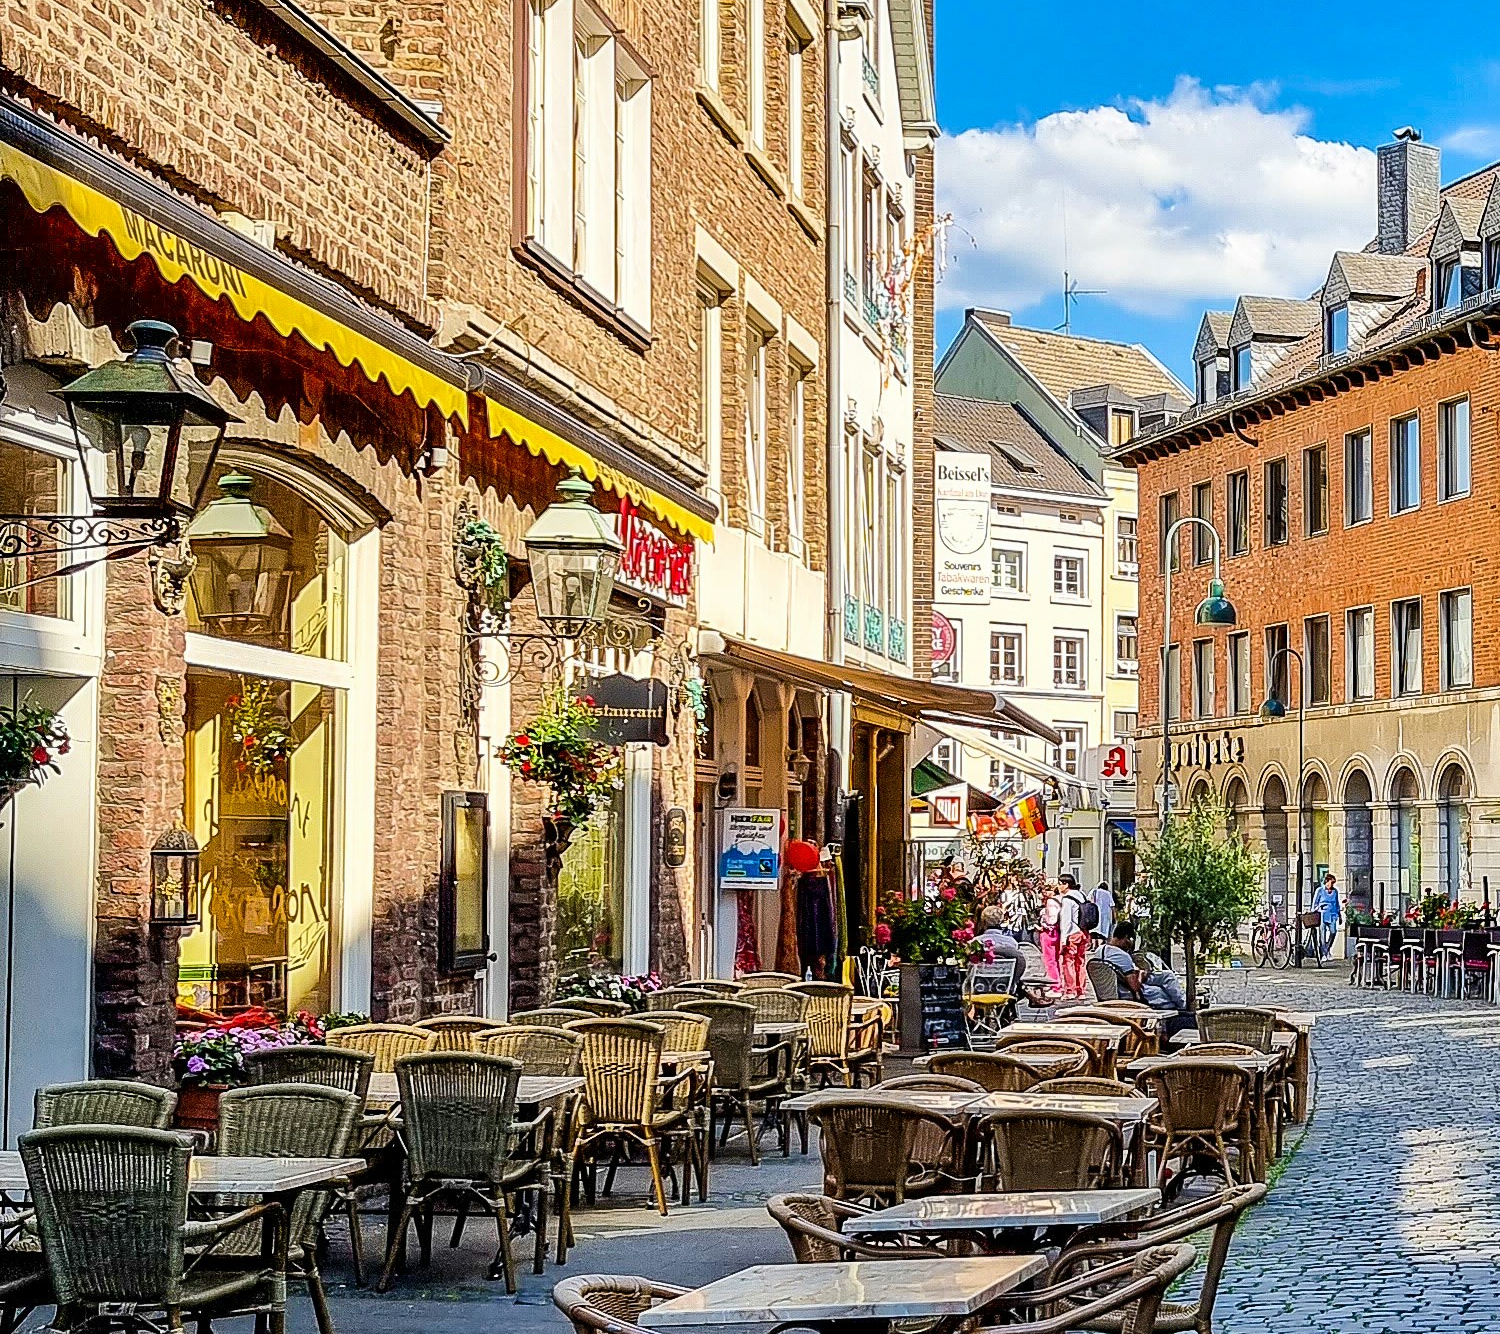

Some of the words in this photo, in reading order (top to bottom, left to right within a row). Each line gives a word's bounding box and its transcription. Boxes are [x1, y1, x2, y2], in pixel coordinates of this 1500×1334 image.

[121, 206, 247, 299] MACARONI
[938, 465, 989, 482] Beissel's
[944, 560, 982, 571] Souvenirs
[938, 572, 989, 584] Tabakwaren
[941, 585, 984, 596] Geschenke
